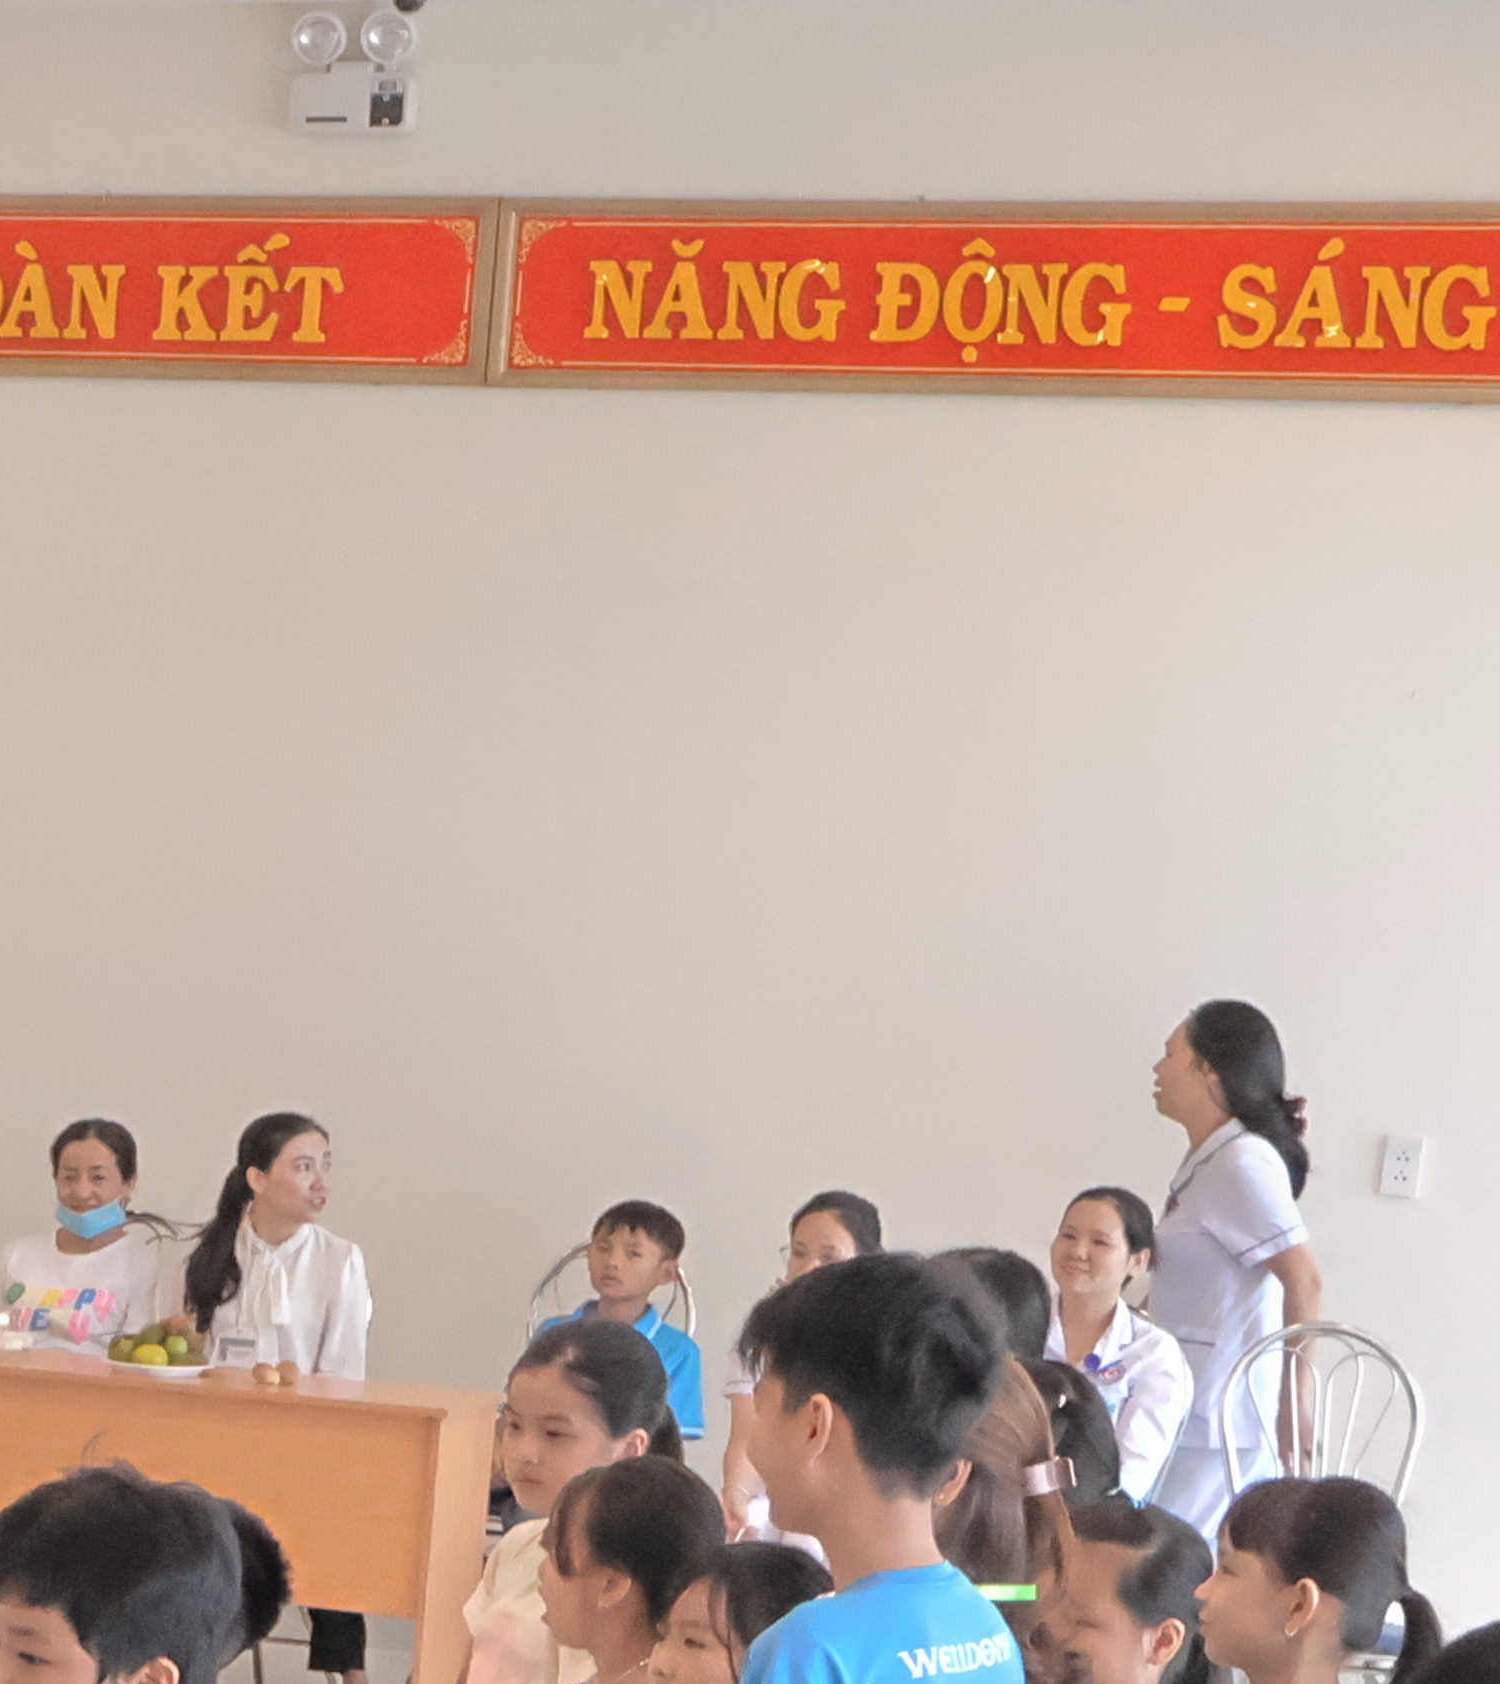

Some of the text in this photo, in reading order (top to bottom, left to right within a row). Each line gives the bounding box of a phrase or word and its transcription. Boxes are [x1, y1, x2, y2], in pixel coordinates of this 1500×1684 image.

[152, 233, 344, 344] KẾT
[584, 239, 847, 342] NĂNG
[869, 238, 1133, 363] ĐỘNG
[1217, 238, 1498, 351] SÁNG
